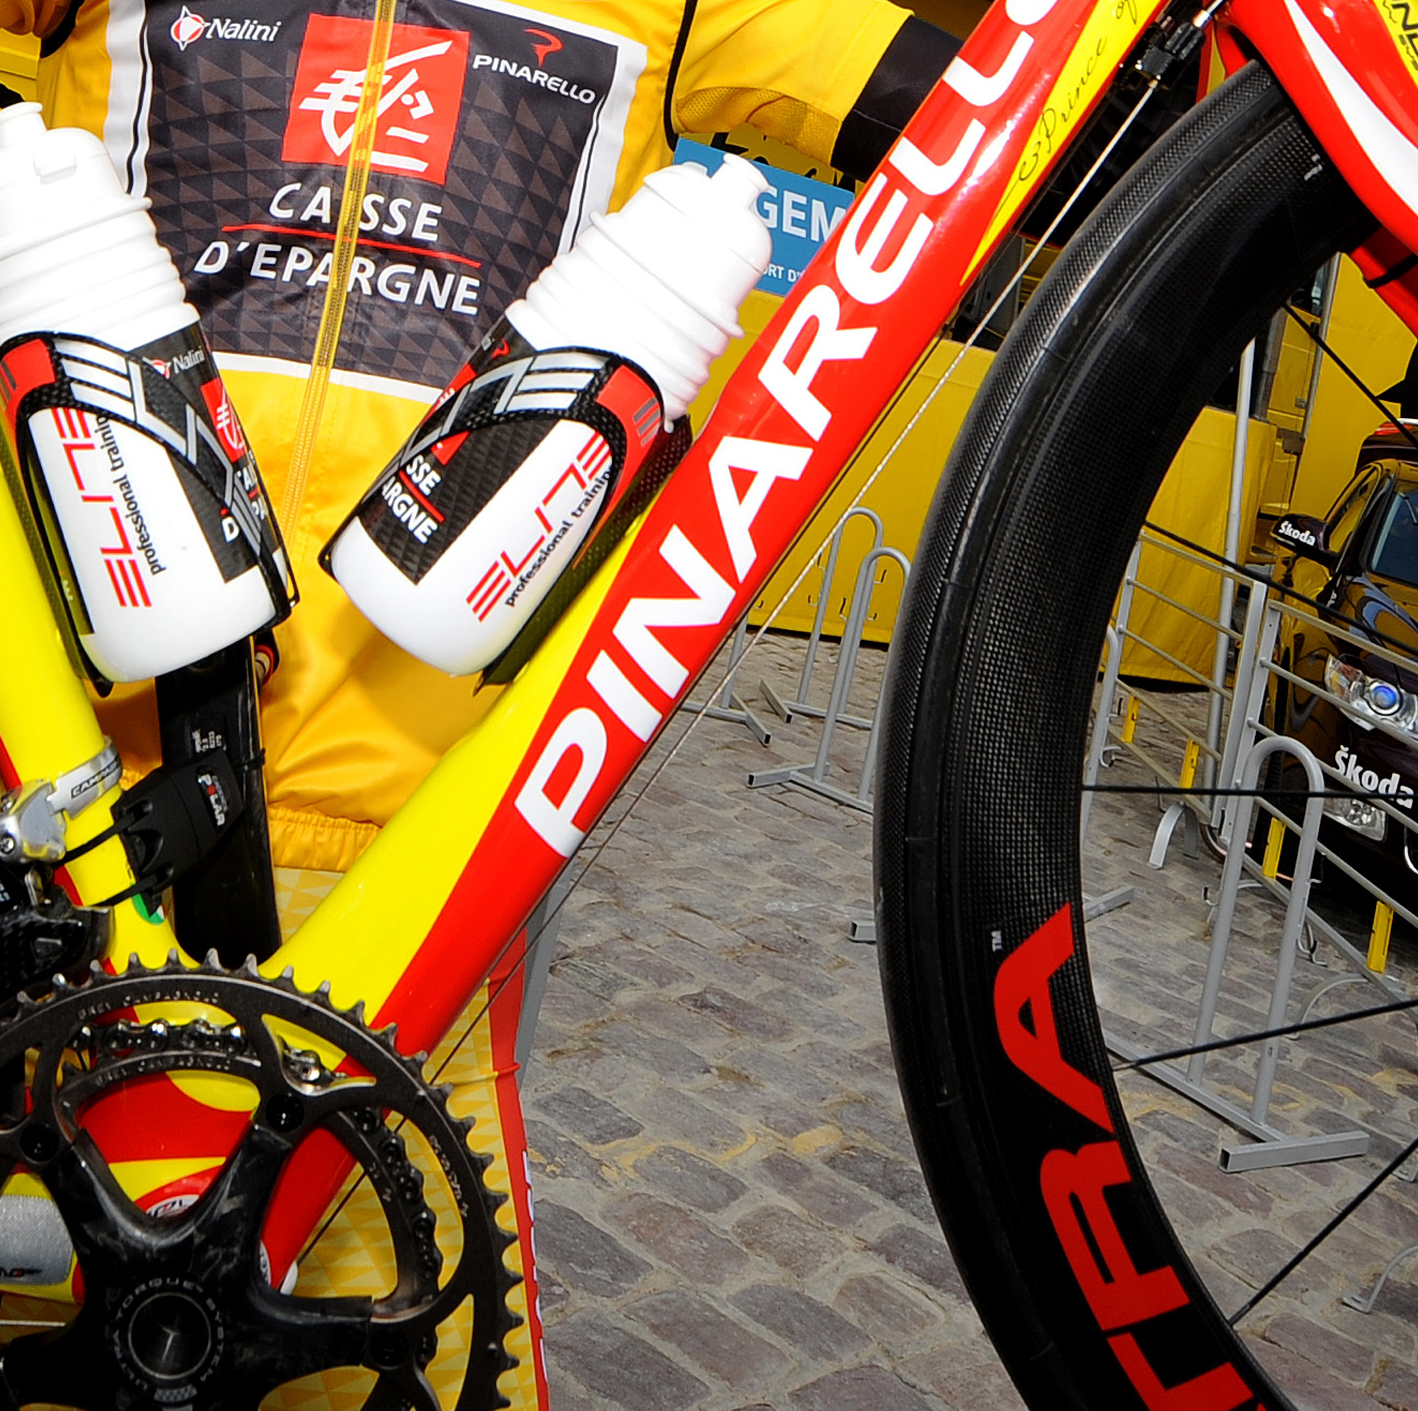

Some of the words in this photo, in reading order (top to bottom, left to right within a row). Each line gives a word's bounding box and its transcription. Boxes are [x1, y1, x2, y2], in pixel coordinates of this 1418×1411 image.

[205, 16, 283, 44] Nalini
[471, 52, 597, 106] PINARELLO
[268, 181, 443, 242] CASSE
[194, 240, 481, 317] D'EPARGNE
[112, 474, 167, 577] professional
[504, 519, 574, 609] professional
[570, 469, 613, 520] trainin
